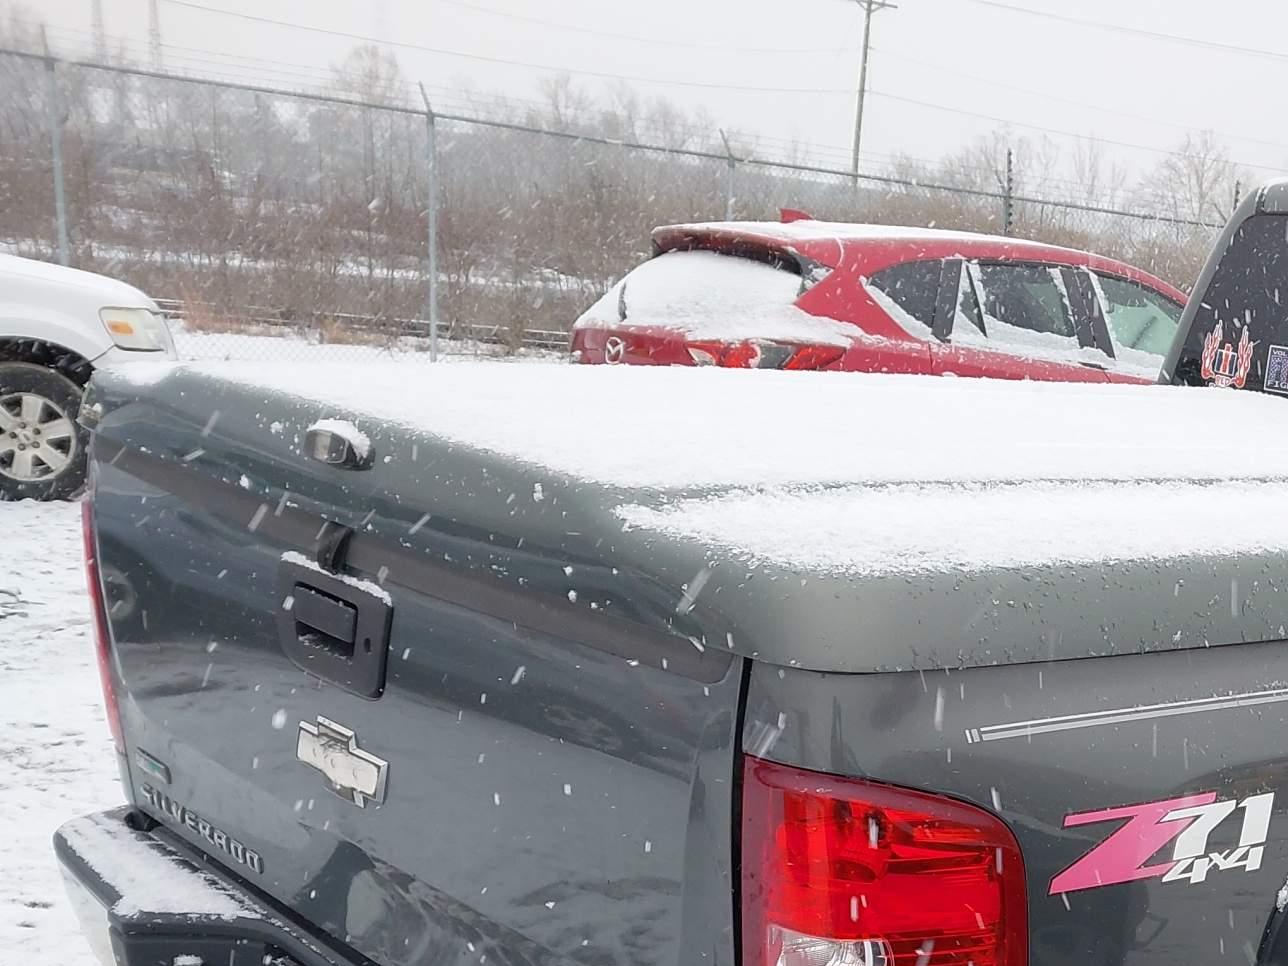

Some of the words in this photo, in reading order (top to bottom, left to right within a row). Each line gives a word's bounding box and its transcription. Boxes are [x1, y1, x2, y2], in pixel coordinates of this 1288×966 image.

[140, 782, 265, 875] SILVERADO
[1048, 792, 1275, 895] Z71
[1161, 845, 1264, 884] 4x4
